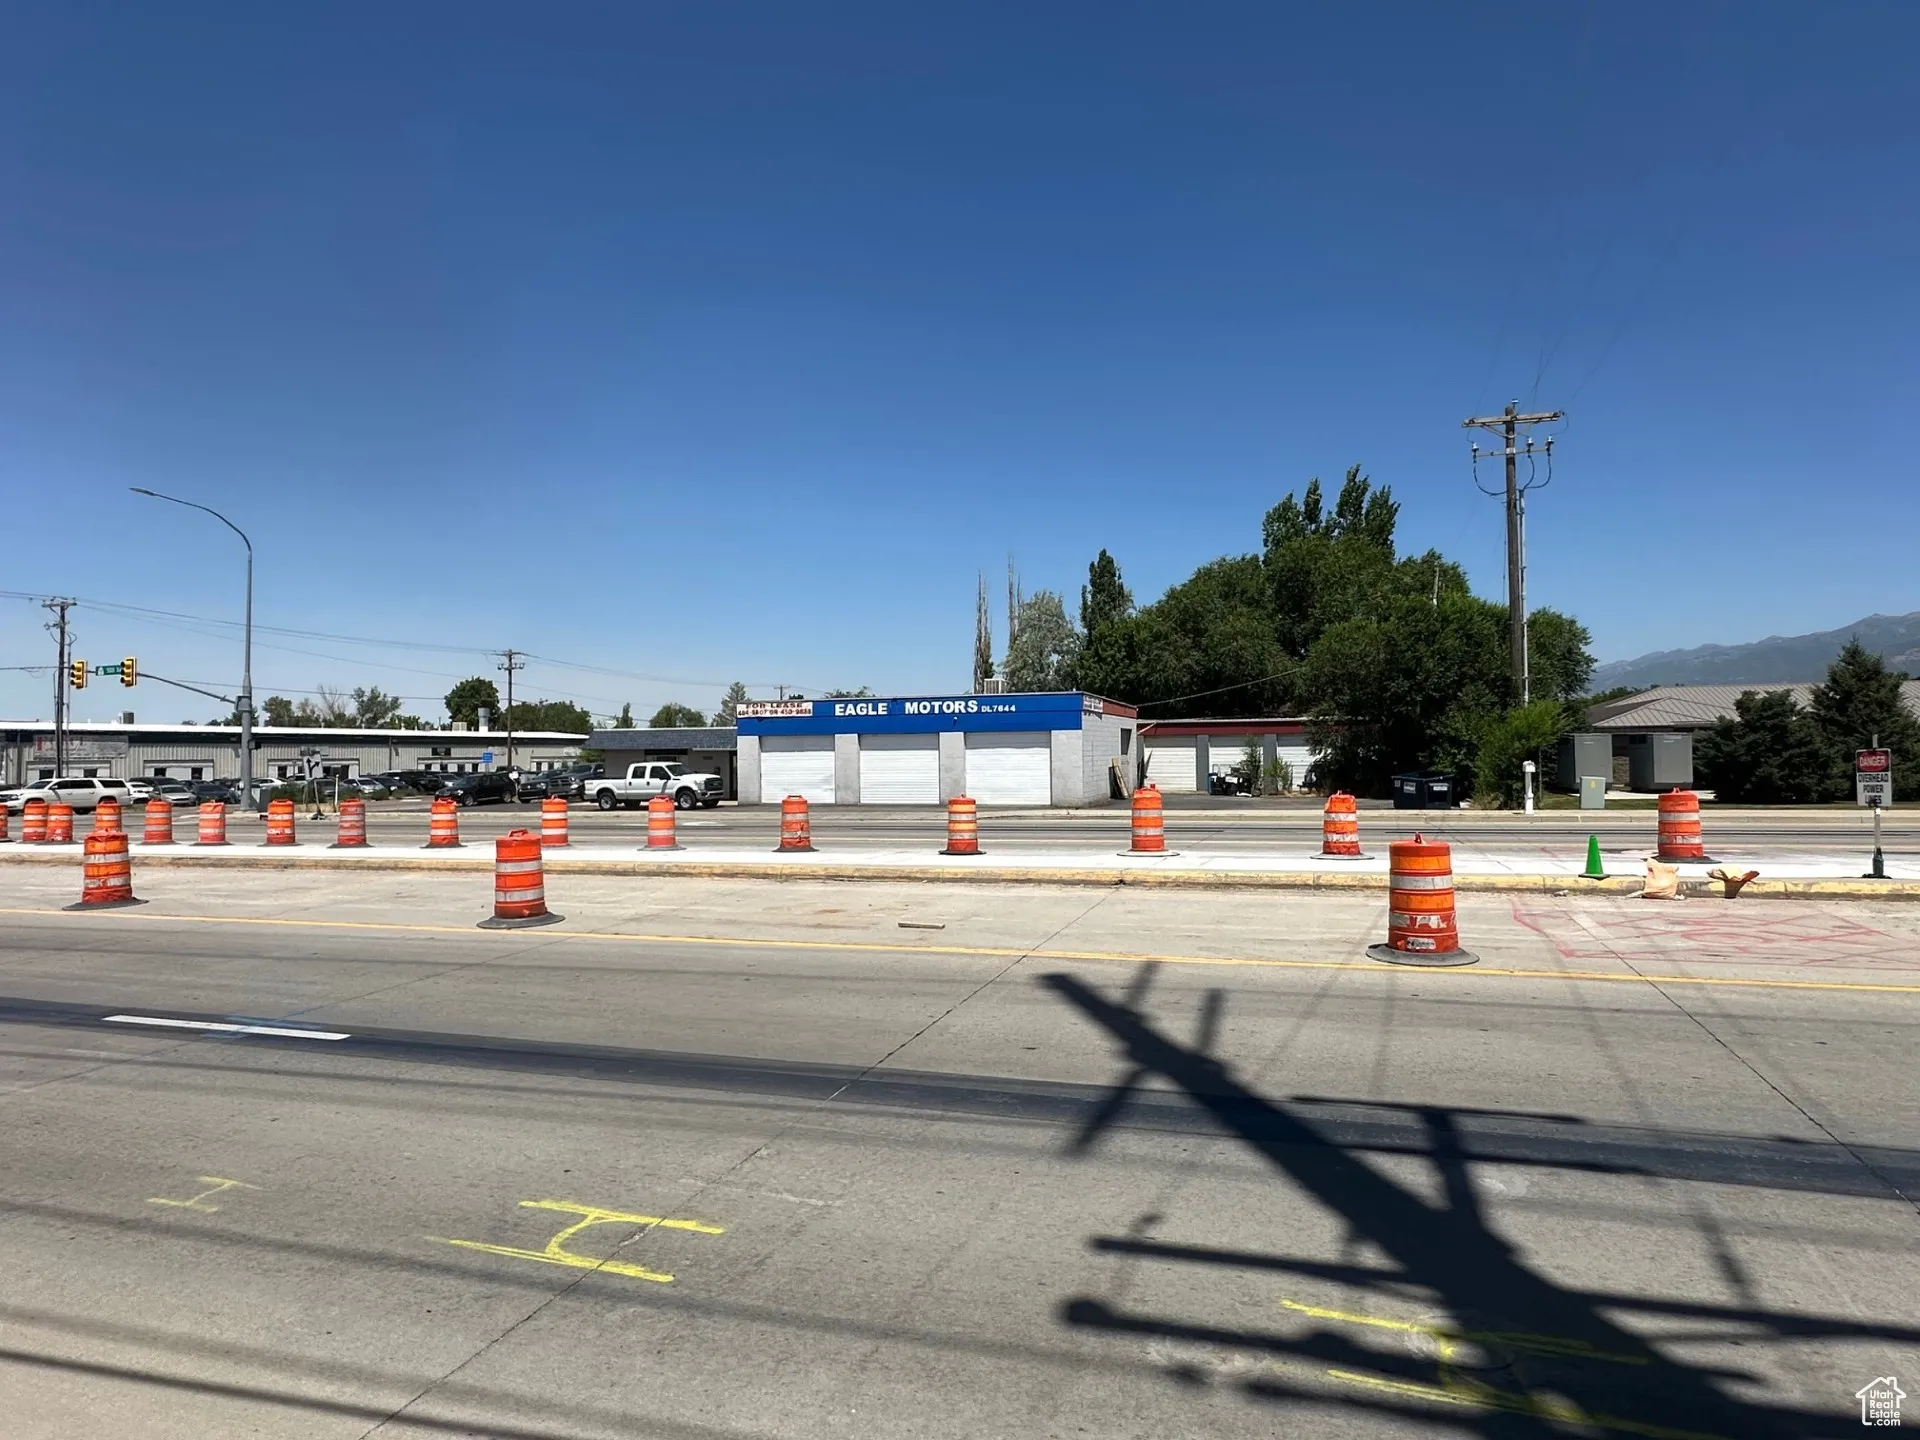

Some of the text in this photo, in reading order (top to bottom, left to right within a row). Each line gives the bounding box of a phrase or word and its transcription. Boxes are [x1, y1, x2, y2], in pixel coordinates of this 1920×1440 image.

[770, 701, 803, 709] LEASE
[834, 700, 1016, 716] EAGLE MOTORS DL7644
[1860, 755, 1886, 766] DANGER
[1858, 773, 1888, 782] OVERHEAD
[1863, 784, 1884, 793] POWER
